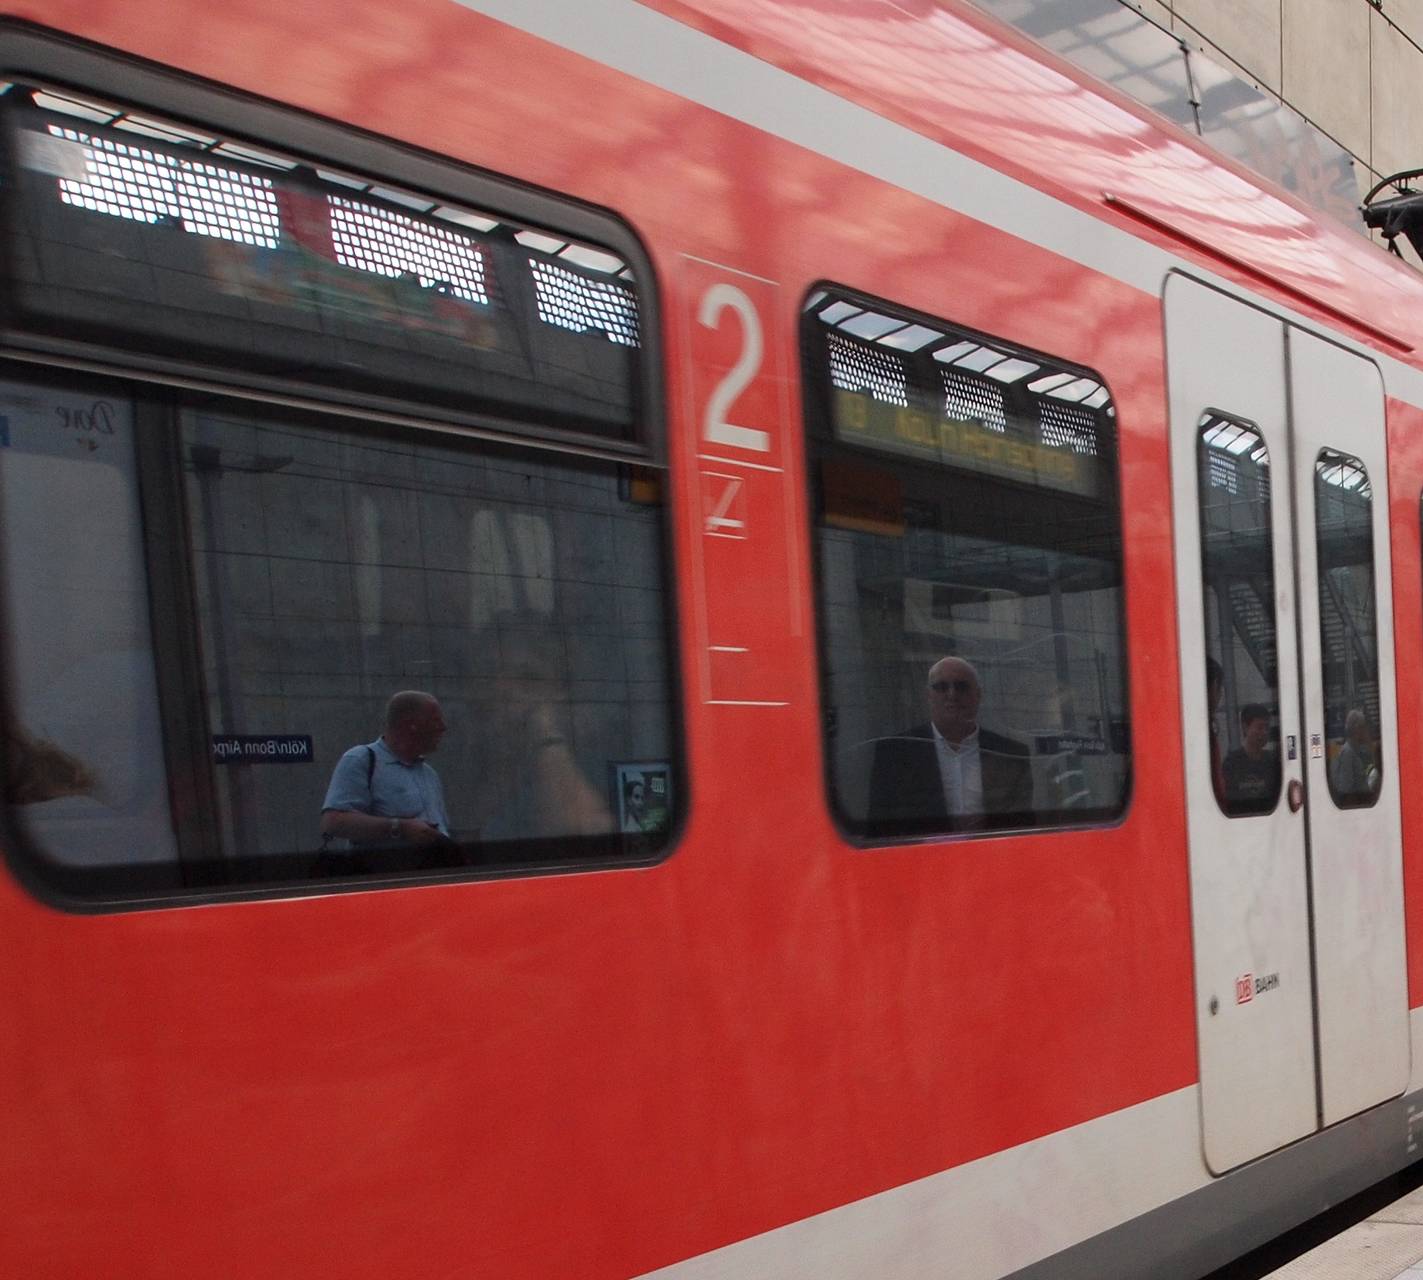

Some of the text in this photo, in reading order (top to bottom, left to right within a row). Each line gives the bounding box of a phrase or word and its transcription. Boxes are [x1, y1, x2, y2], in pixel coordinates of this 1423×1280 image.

[698, 283, 771, 452] 2
[1236, 973, 1280, 1004] DB BAHN
